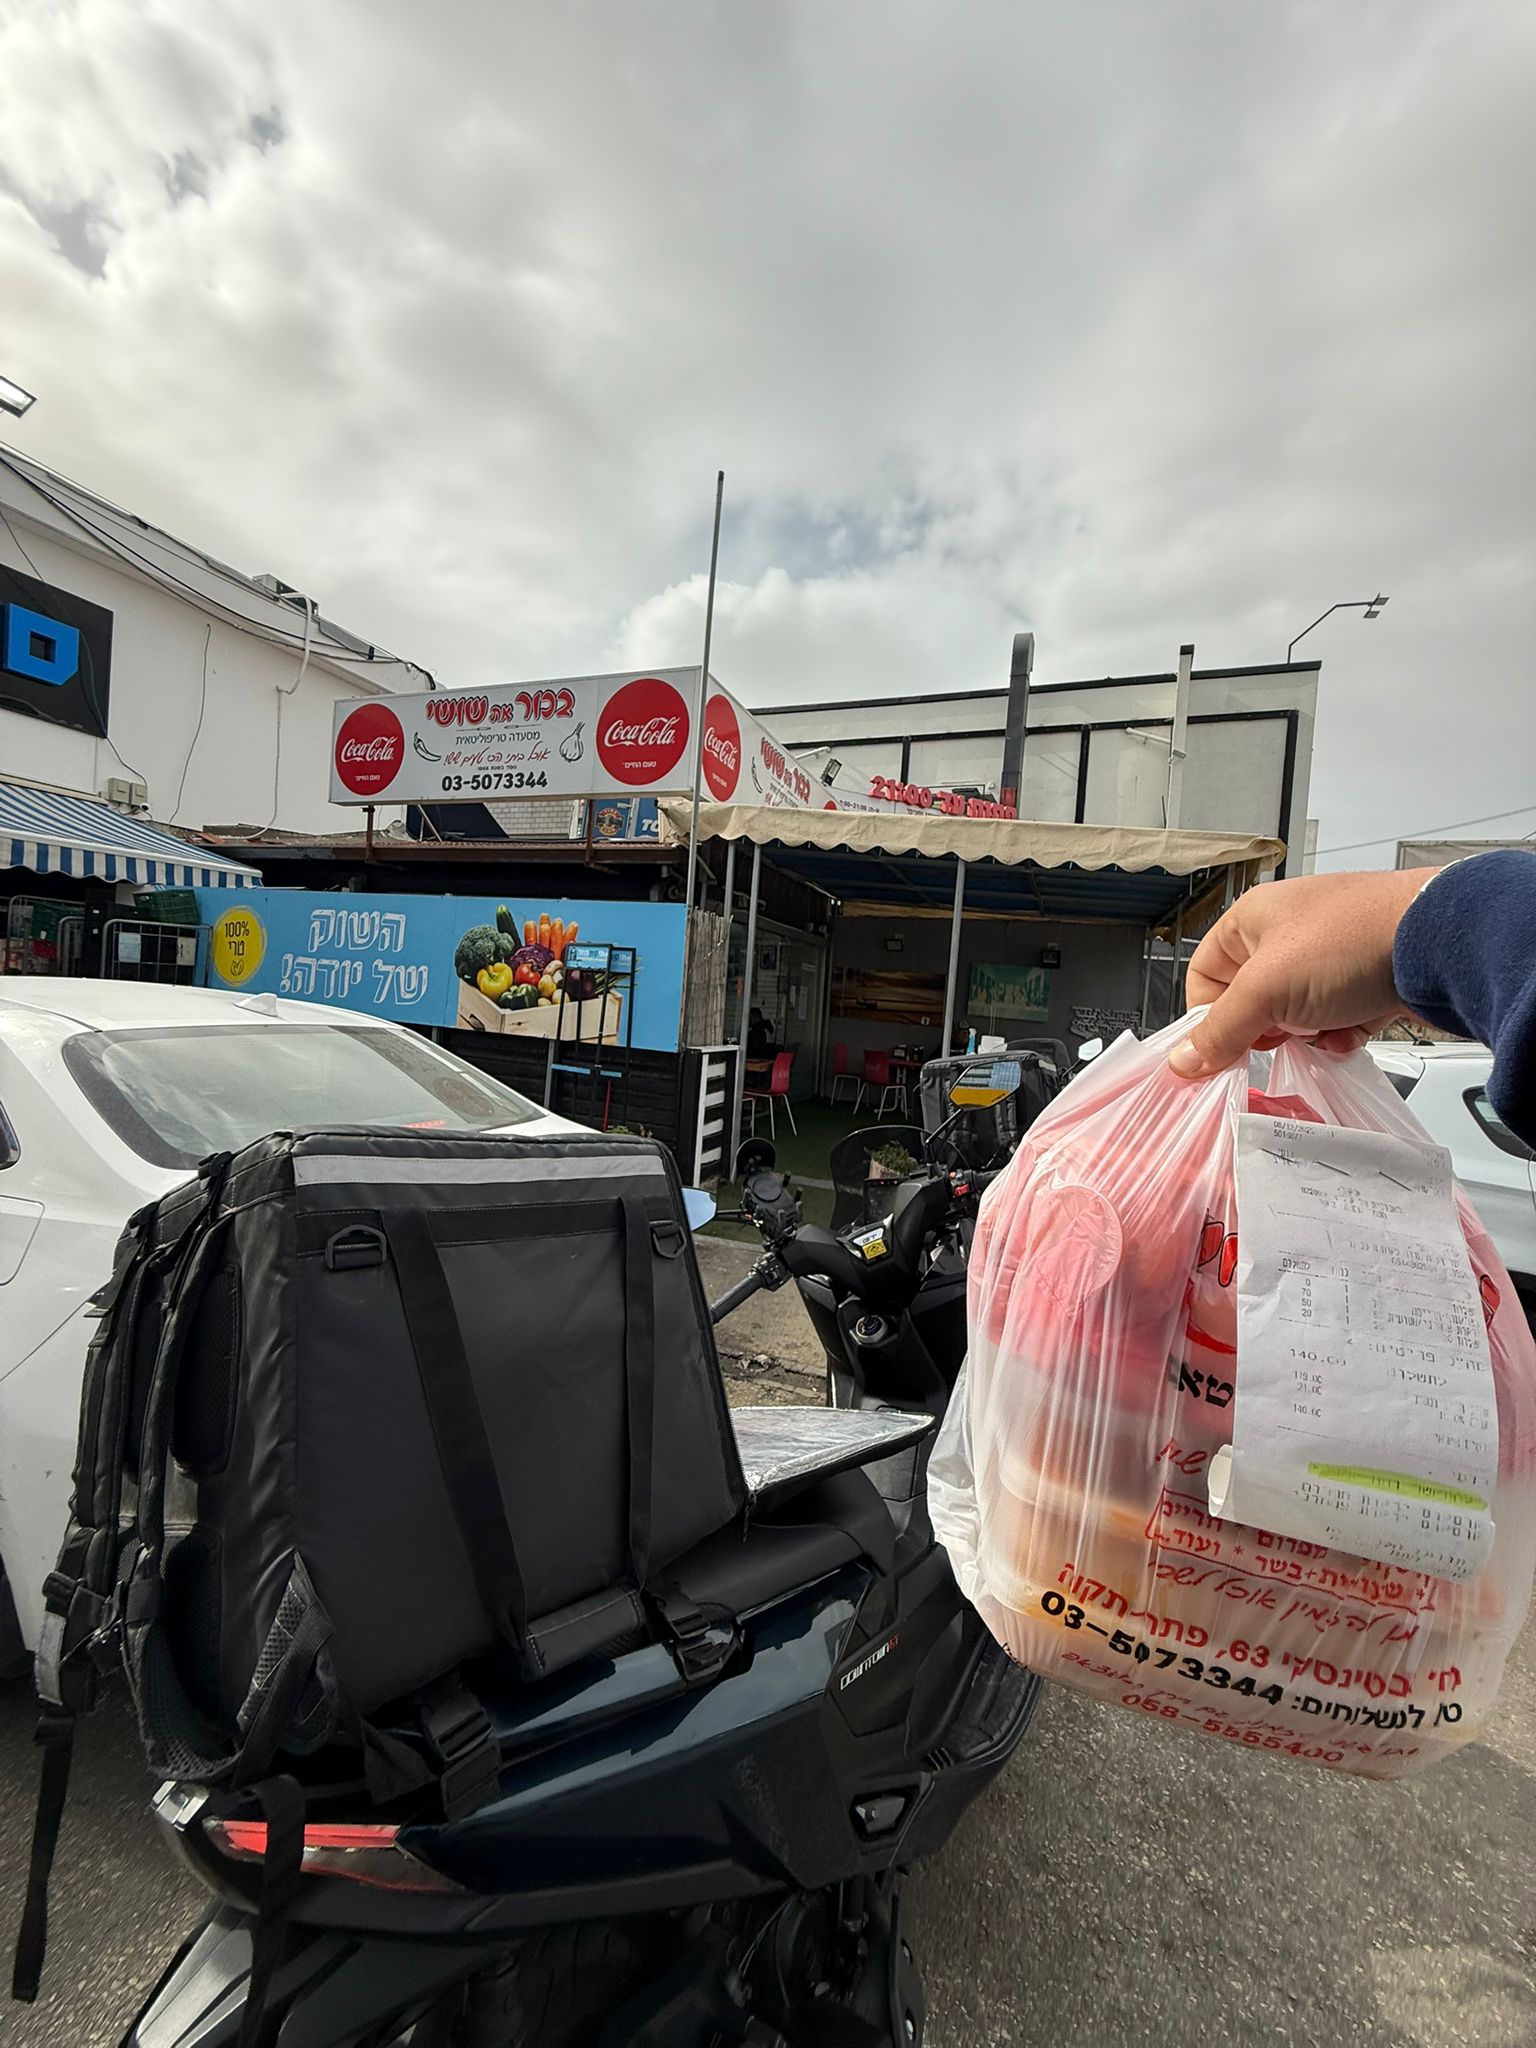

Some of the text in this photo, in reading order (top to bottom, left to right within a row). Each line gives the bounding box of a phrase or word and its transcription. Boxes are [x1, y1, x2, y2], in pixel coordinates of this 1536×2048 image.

[425, 688, 575, 728] בכור את שושי
[456, 731, 541, 745] מסעדה טריפוליטאית
[460, 747, 490, 767] טעים
[487, 752, 502, 763] הכי
[527, 741, 551, 761] אוכל
[442, 771, 547, 791] 03-5073344
[869, 776, 932, 808] 21:00
[225, 921, 250, 938] 100%
[308, 909, 406, 953] השוק
[228, 941, 245, 956] טרי
[280, 953, 428, 1005] של יודה!
[1305, 1278, 1311, 1287] 0
[1301, 1288, 1312, 1297] 70
[1301, 1299, 1312, 1307] 50
[1301, 1309, 1312, 1318] 20
[1040, 1590, 1285, 1706] 03-5073344
